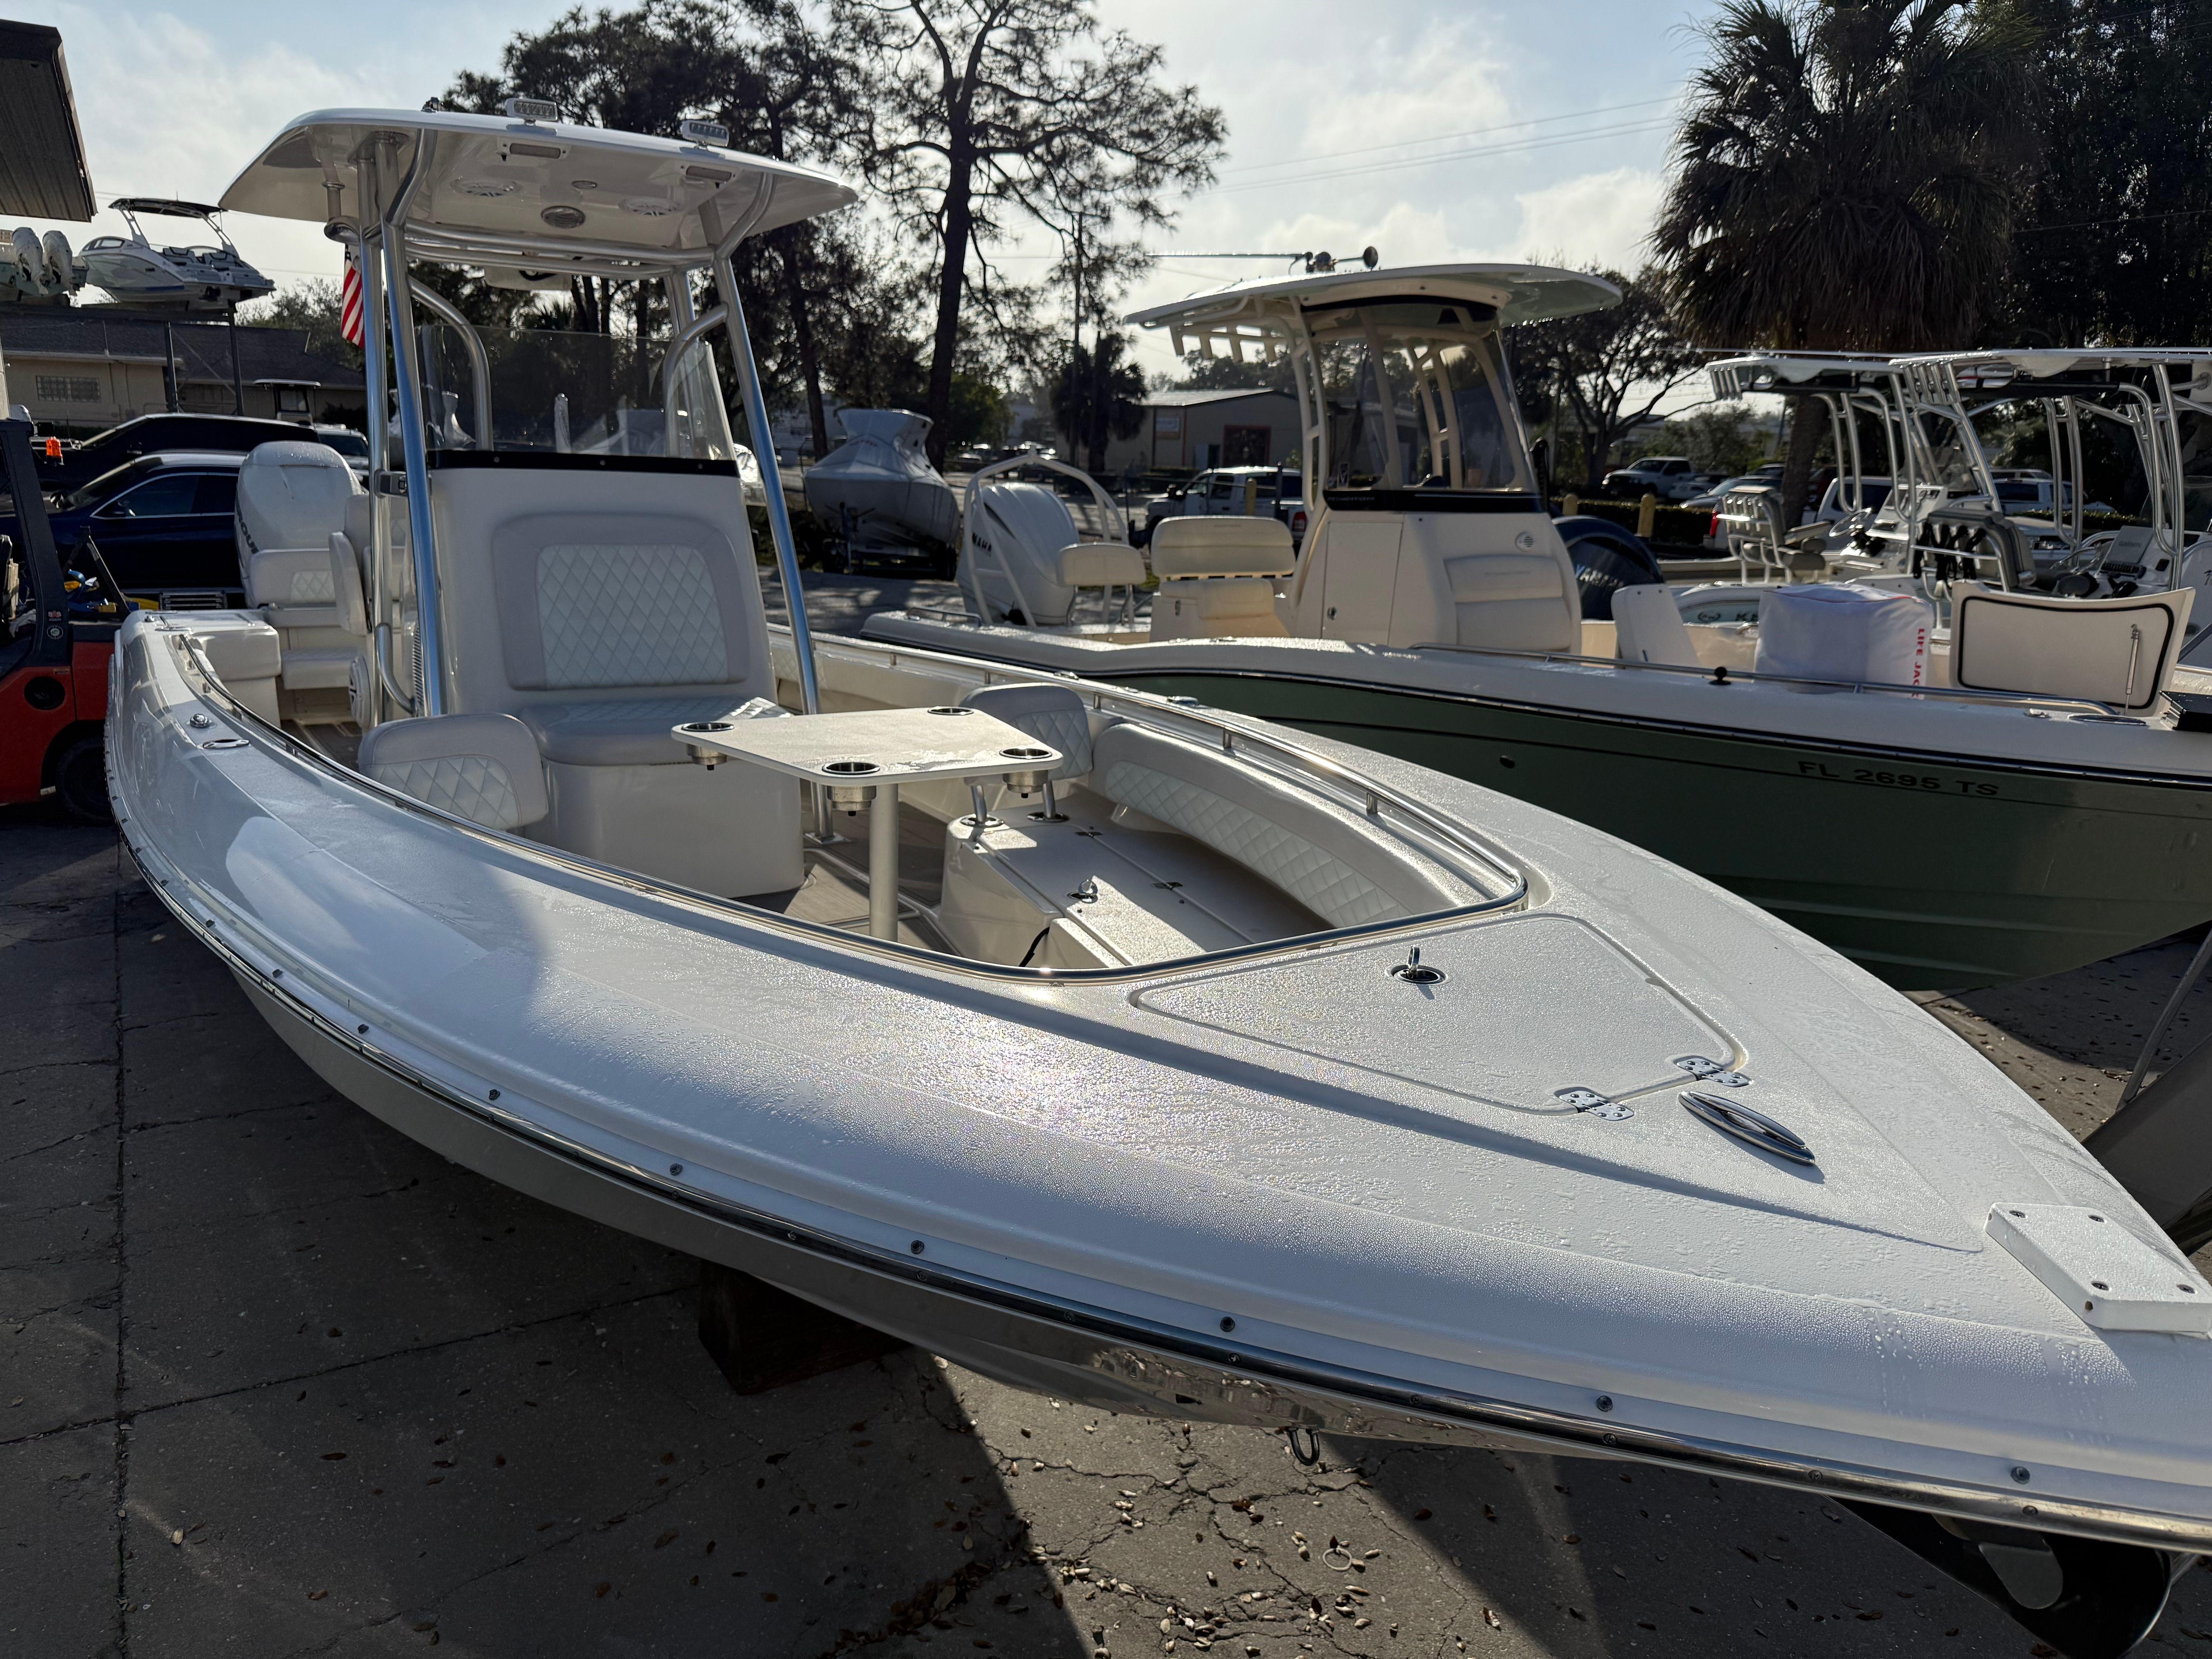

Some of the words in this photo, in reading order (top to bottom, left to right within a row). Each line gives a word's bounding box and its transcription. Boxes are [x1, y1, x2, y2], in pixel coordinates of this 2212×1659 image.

[1916, 628, 1925, 655] LIFE
[1798, 761, 1839, 778] FL
[1853, 769, 1940, 790] 2695
[1956, 780, 1999, 796] TS
